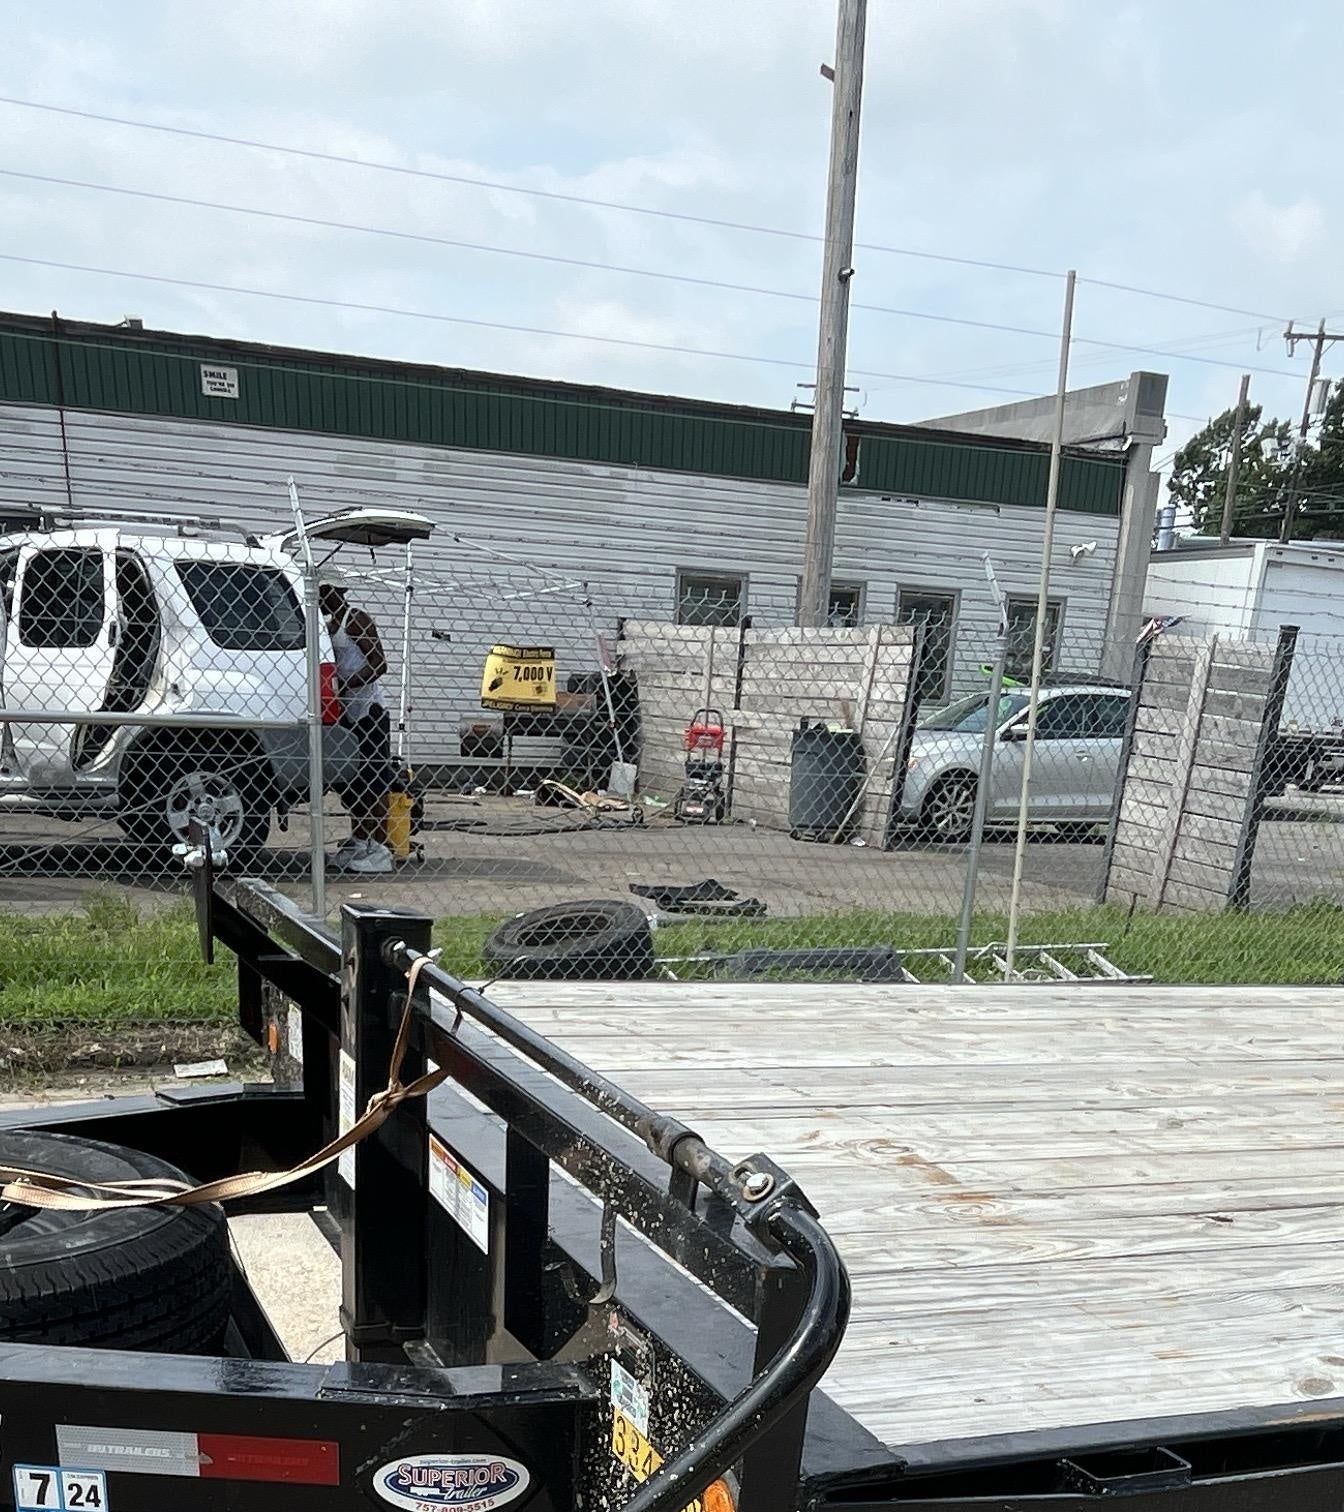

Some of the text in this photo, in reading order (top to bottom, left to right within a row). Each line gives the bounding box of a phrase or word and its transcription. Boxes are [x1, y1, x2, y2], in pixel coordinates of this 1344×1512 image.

[514, 666, 553, 682] 7,000 V
[398, 1462, 507, 1488] SUPERIOR
[29, 1472, 101, 1507] 7 24
